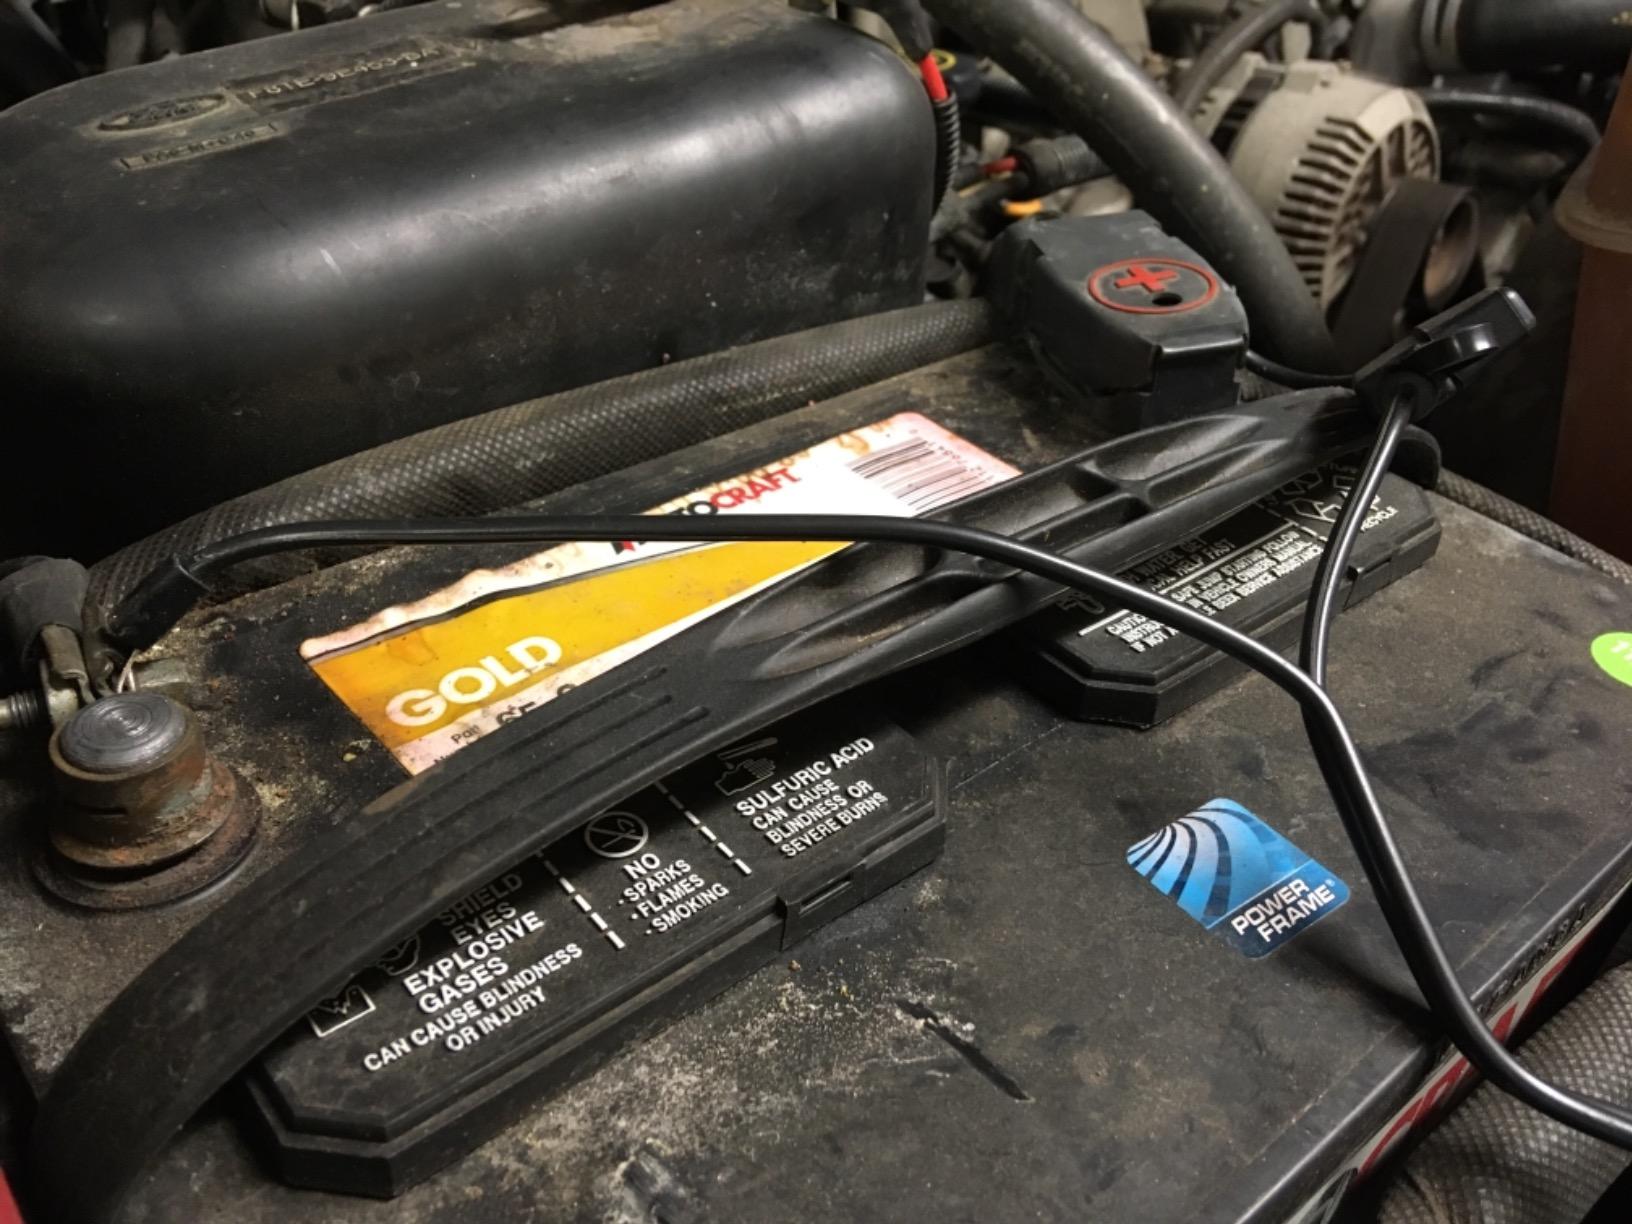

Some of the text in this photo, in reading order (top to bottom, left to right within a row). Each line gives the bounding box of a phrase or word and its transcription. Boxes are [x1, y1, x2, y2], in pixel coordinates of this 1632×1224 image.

[1207, 538, 1236, 560] FAST
[1105, 612, 1150, 636] CAUTIO
[1171, 584, 1200, 603] SAFE
[1199, 571, 1224, 590] JUMP
[1221, 549, 1267, 577] STARTING
[1263, 531, 1301, 554] FOLLOW
[1200, 576, 1241, 602] VEHICLE
[1236, 573, 1278, 598] SERVICE
[1145, 628, 1170, 648] NOT
[385, 636, 563, 726] GOLD
[736, 737, 874, 816] SULFURIC ACID
[752, 778, 839, 830] CAN CAUSE
[765, 779, 874, 844] BLINDNESS OR
[781, 791, 888, 857] SEVERE BURNS
[623, 853, 661, 880] NO
[623, 859, 691, 902] SPARKS
[438, 873, 523, 926] SHIELD
[636, 873, 705, 918] FLAMES
[651, 882, 729, 933] SMOKING
[1231, 879, 1310, 936] POWER
[1256, 884, 1336, 942] FRAME
[451, 902, 517, 946] EYES
[403, 911, 545, 995] EXPLOSIVE
[363, 943, 583, 1071] CAN CAUSE BLINDNESS
[419, 957, 509, 1014] GASES
[446, 986, 547, 1051] OR INJURY
